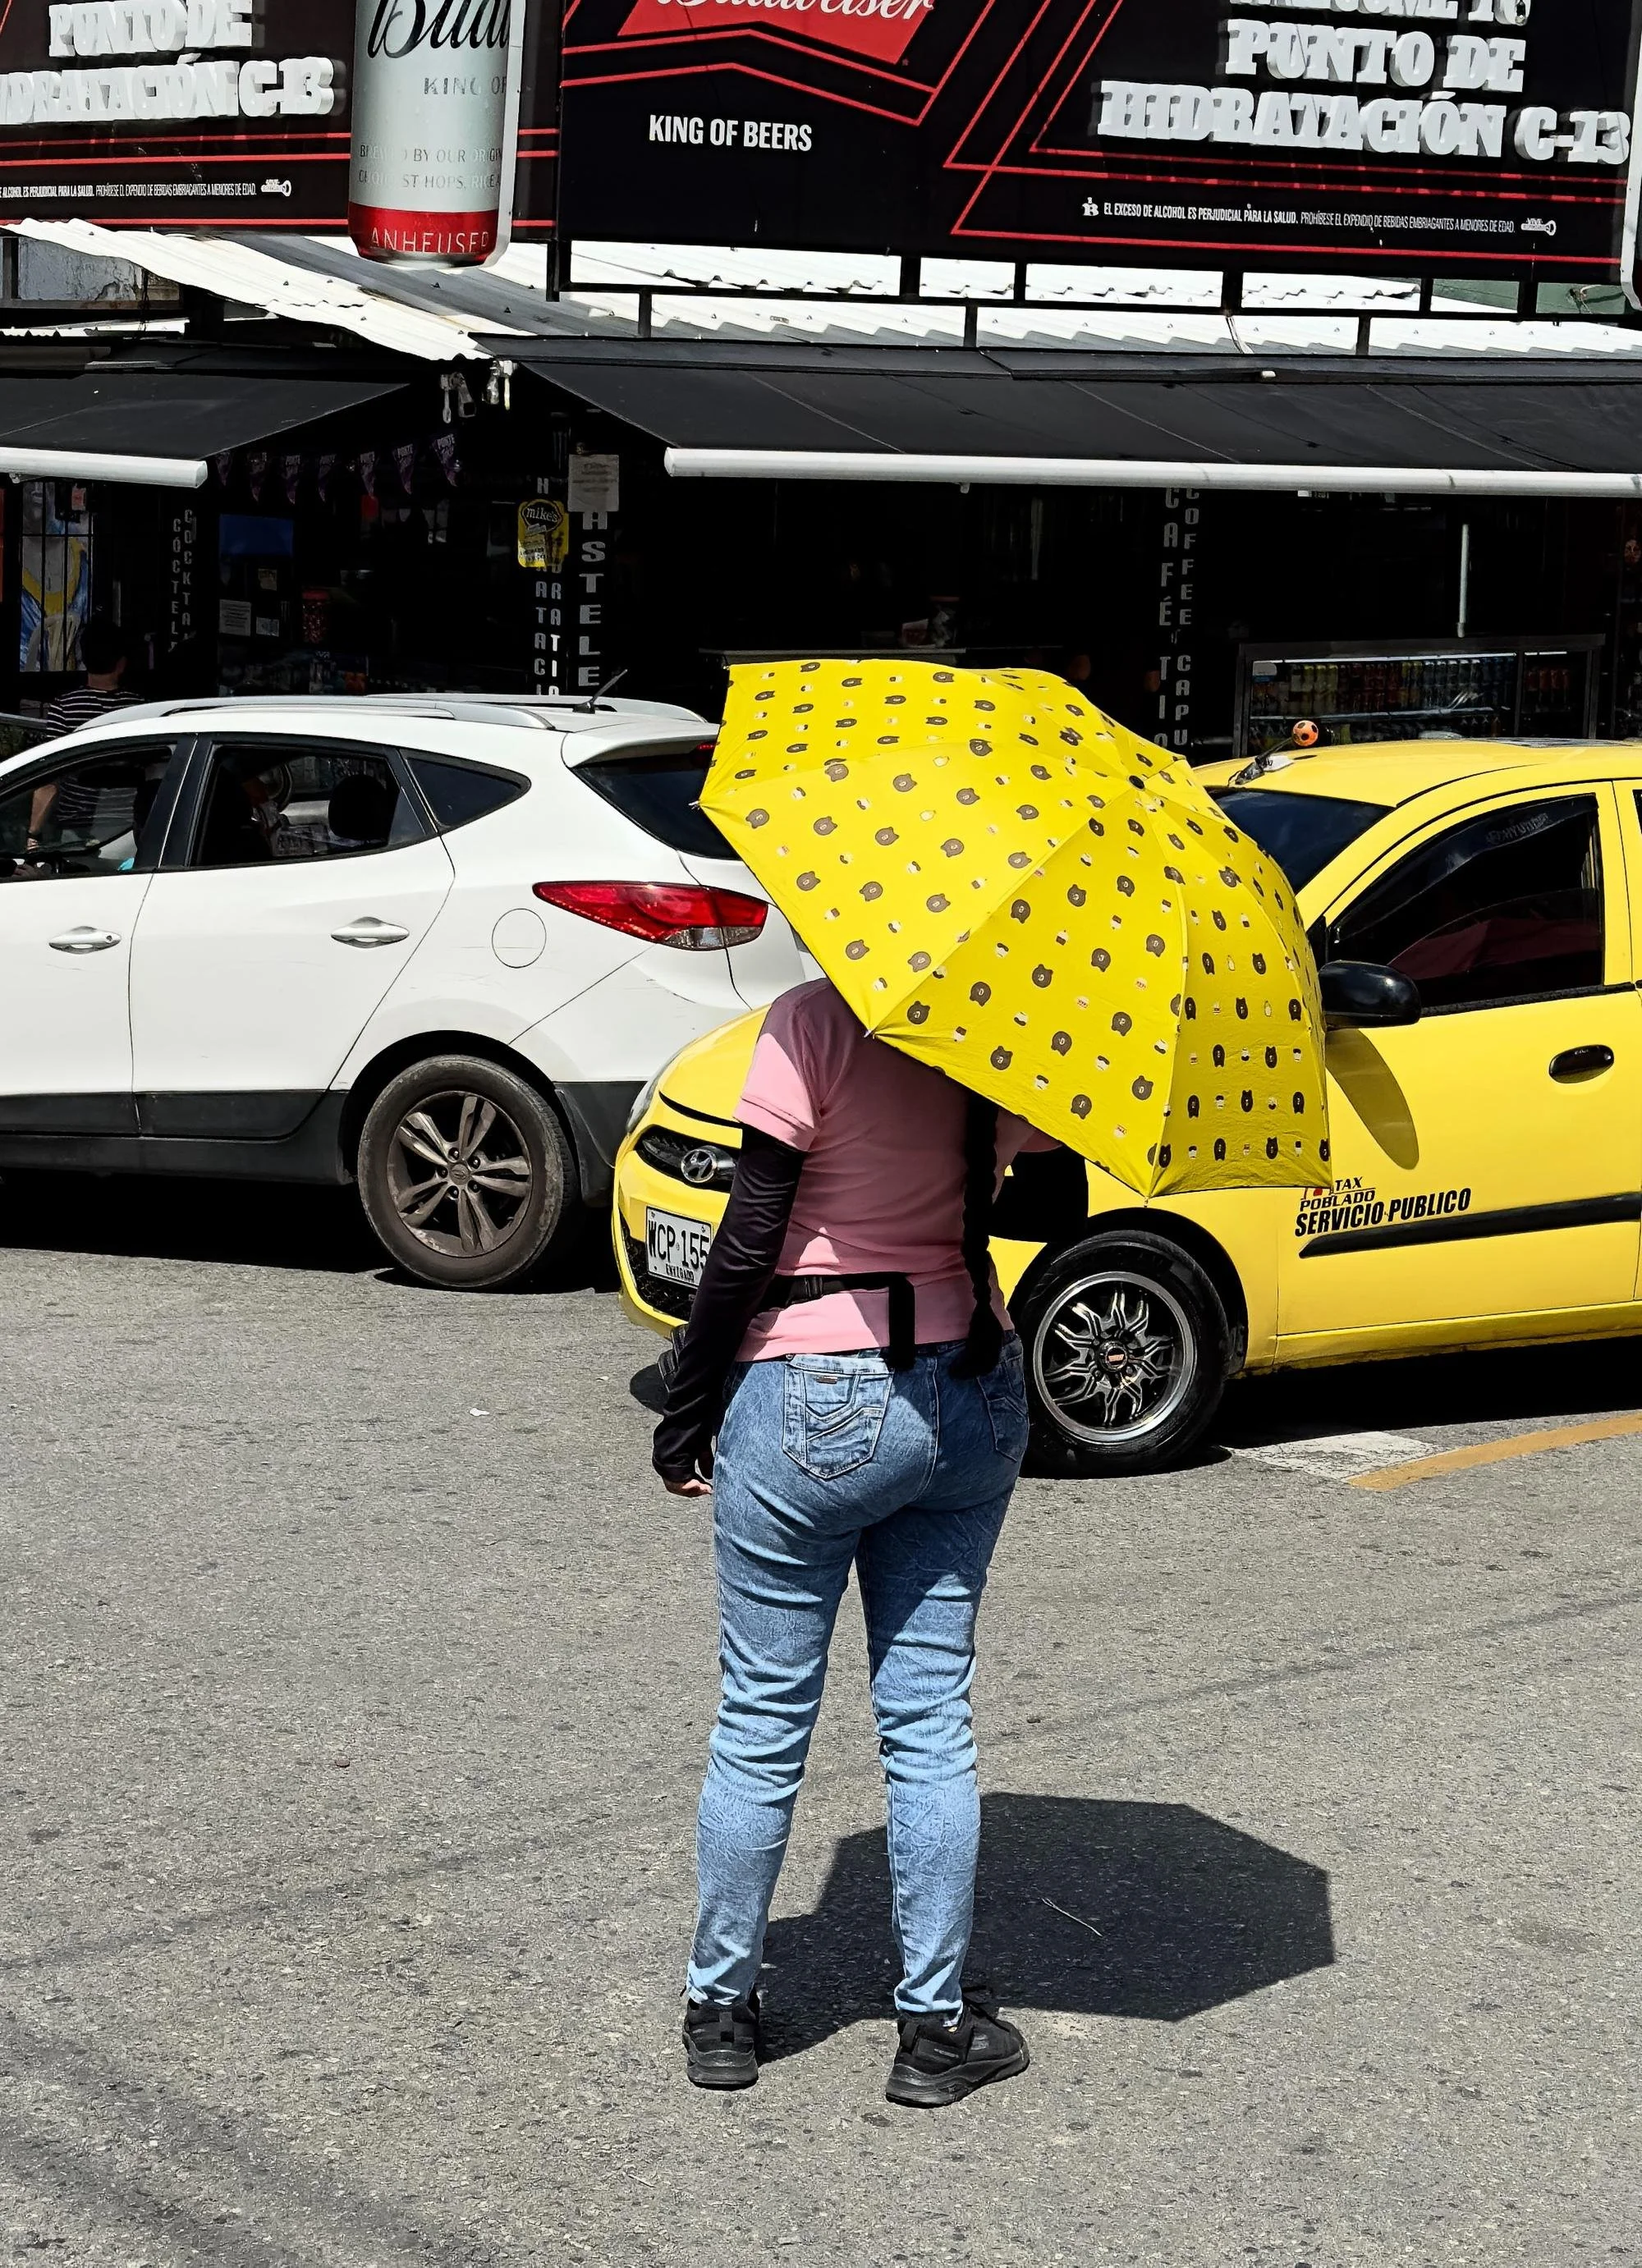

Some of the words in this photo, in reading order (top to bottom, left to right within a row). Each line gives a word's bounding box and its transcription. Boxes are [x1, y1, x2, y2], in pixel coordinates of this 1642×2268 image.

[49, 1, 186, 57] PUNTO
[186, 0, 252, 47] DE
[1226, 19, 1434, 86] PUNTO
[1442, 34, 1526, 92] DE
[0, 53, 239, 125] DRATACIÓN
[649, 114, 704, 144] KING
[710, 118, 737, 146] OF
[744, 121, 812, 151] BEERS
[1098, 80, 1506, 157] HIDRATACIÓN
[1516, 106, 1631, 163] C-13
[414, 148, 429, 162] BY
[71, 185, 77, 197] LA
[1103, 202, 1112, 215] EL
[1114, 203, 1141, 217] EXCESO
[1143, 204, 1153, 218] DE
[1154, 205, 1186, 219] ALCOHOL
[1187, 207, 1196, 219] ES
[1198, 207, 1242, 222] PERJUDICIAL
[1244, 209, 1262, 222] PARA
[1263, 210, 1272, 222] LA
[1273, 210, 1298, 224] SALUD.
[1374, 215, 1383, 227] DE
[1383, 215, 1408, 228] BEBIDAS
[1409, 216, 1454, 231] EMBRIAGANTES
[1455, 219, 1460, 231] A
[1461, 218, 1488, 231] MENORES
[1489, 220, 1498, 232] DE
[1158, 488, 1180, 626] CAFÉ
[1179, 487, 1199, 625] COFFEE
[1174, 654, 1191, 745] CAPU
[1300, 1189, 1376, 1212] POBLADO
[1335, 1176, 1363, 1191] TAX
[1295, 1201, 1384, 1237] SERVICIO
[1387, 1188, 1471, 1222] PUBLICO
[648, 1220, 676, 1263] WCP
[681, 1230, 710, 1271] 155
